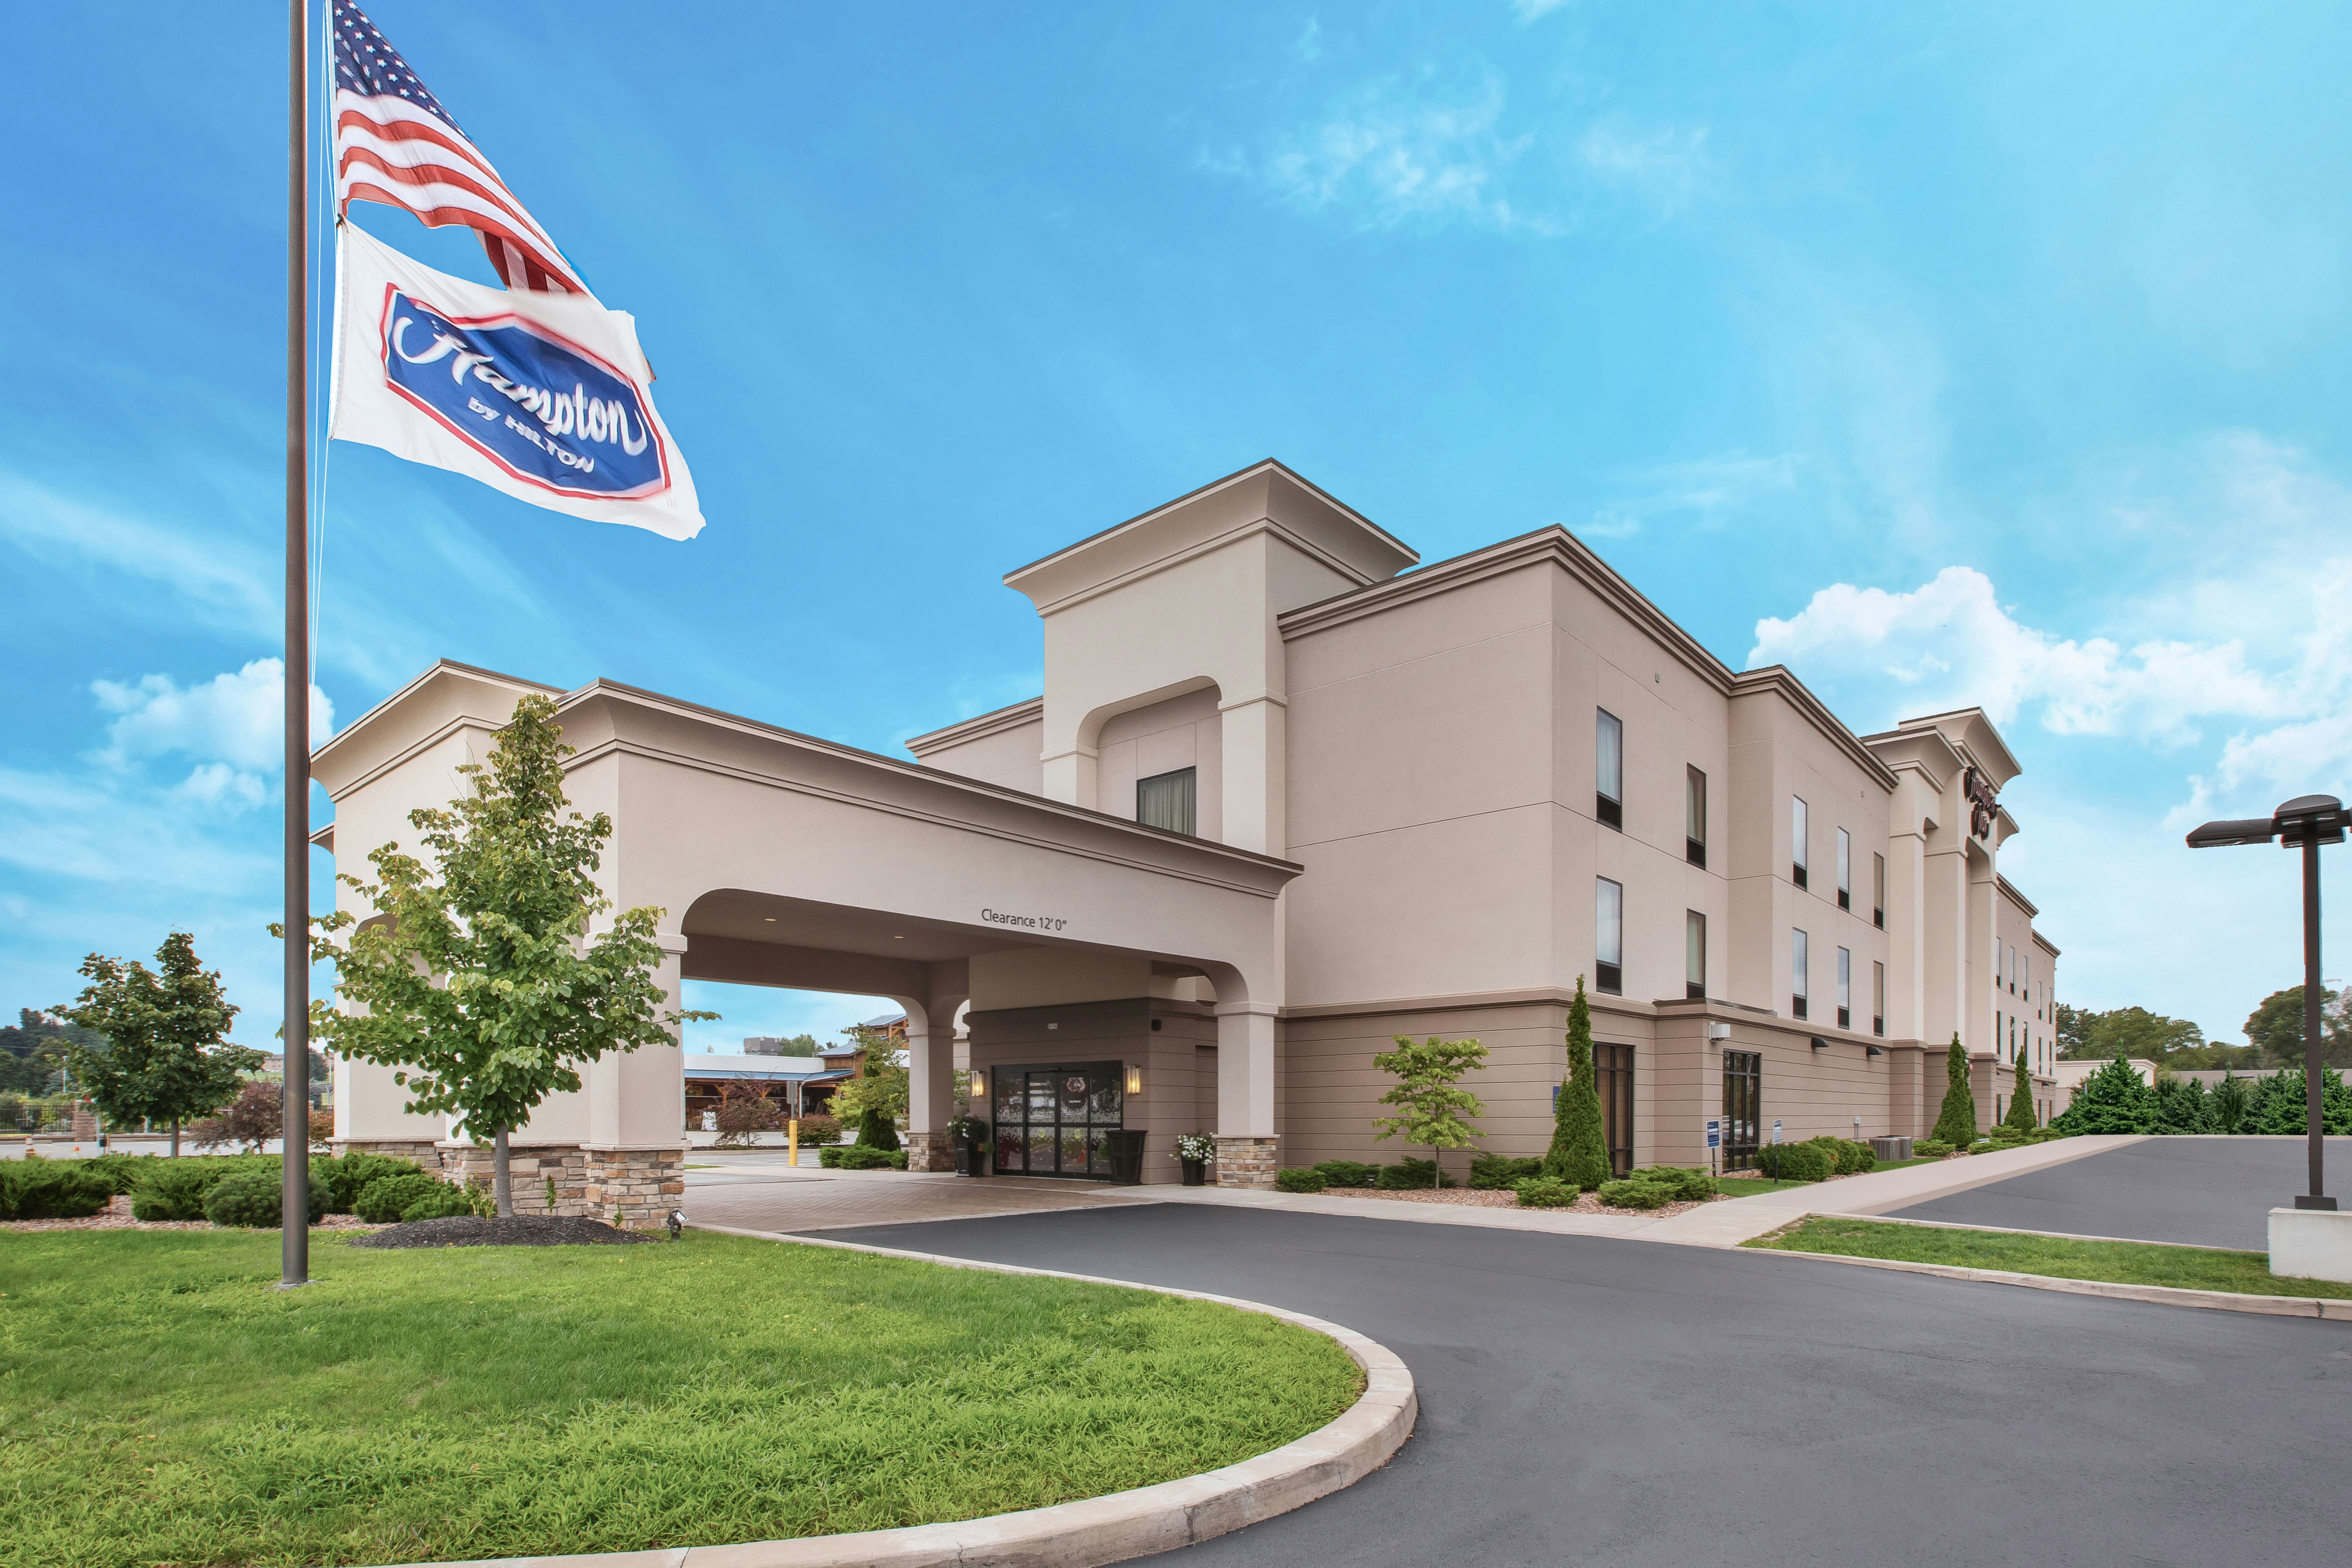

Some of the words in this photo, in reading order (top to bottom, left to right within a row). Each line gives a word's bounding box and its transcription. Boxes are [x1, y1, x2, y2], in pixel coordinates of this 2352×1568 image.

[392, 317, 648, 456] Hampton
[468, 396, 501, 421] by
[504, 414, 595, 473] HILTON
[981, 909, 1035, 928] Clearance
